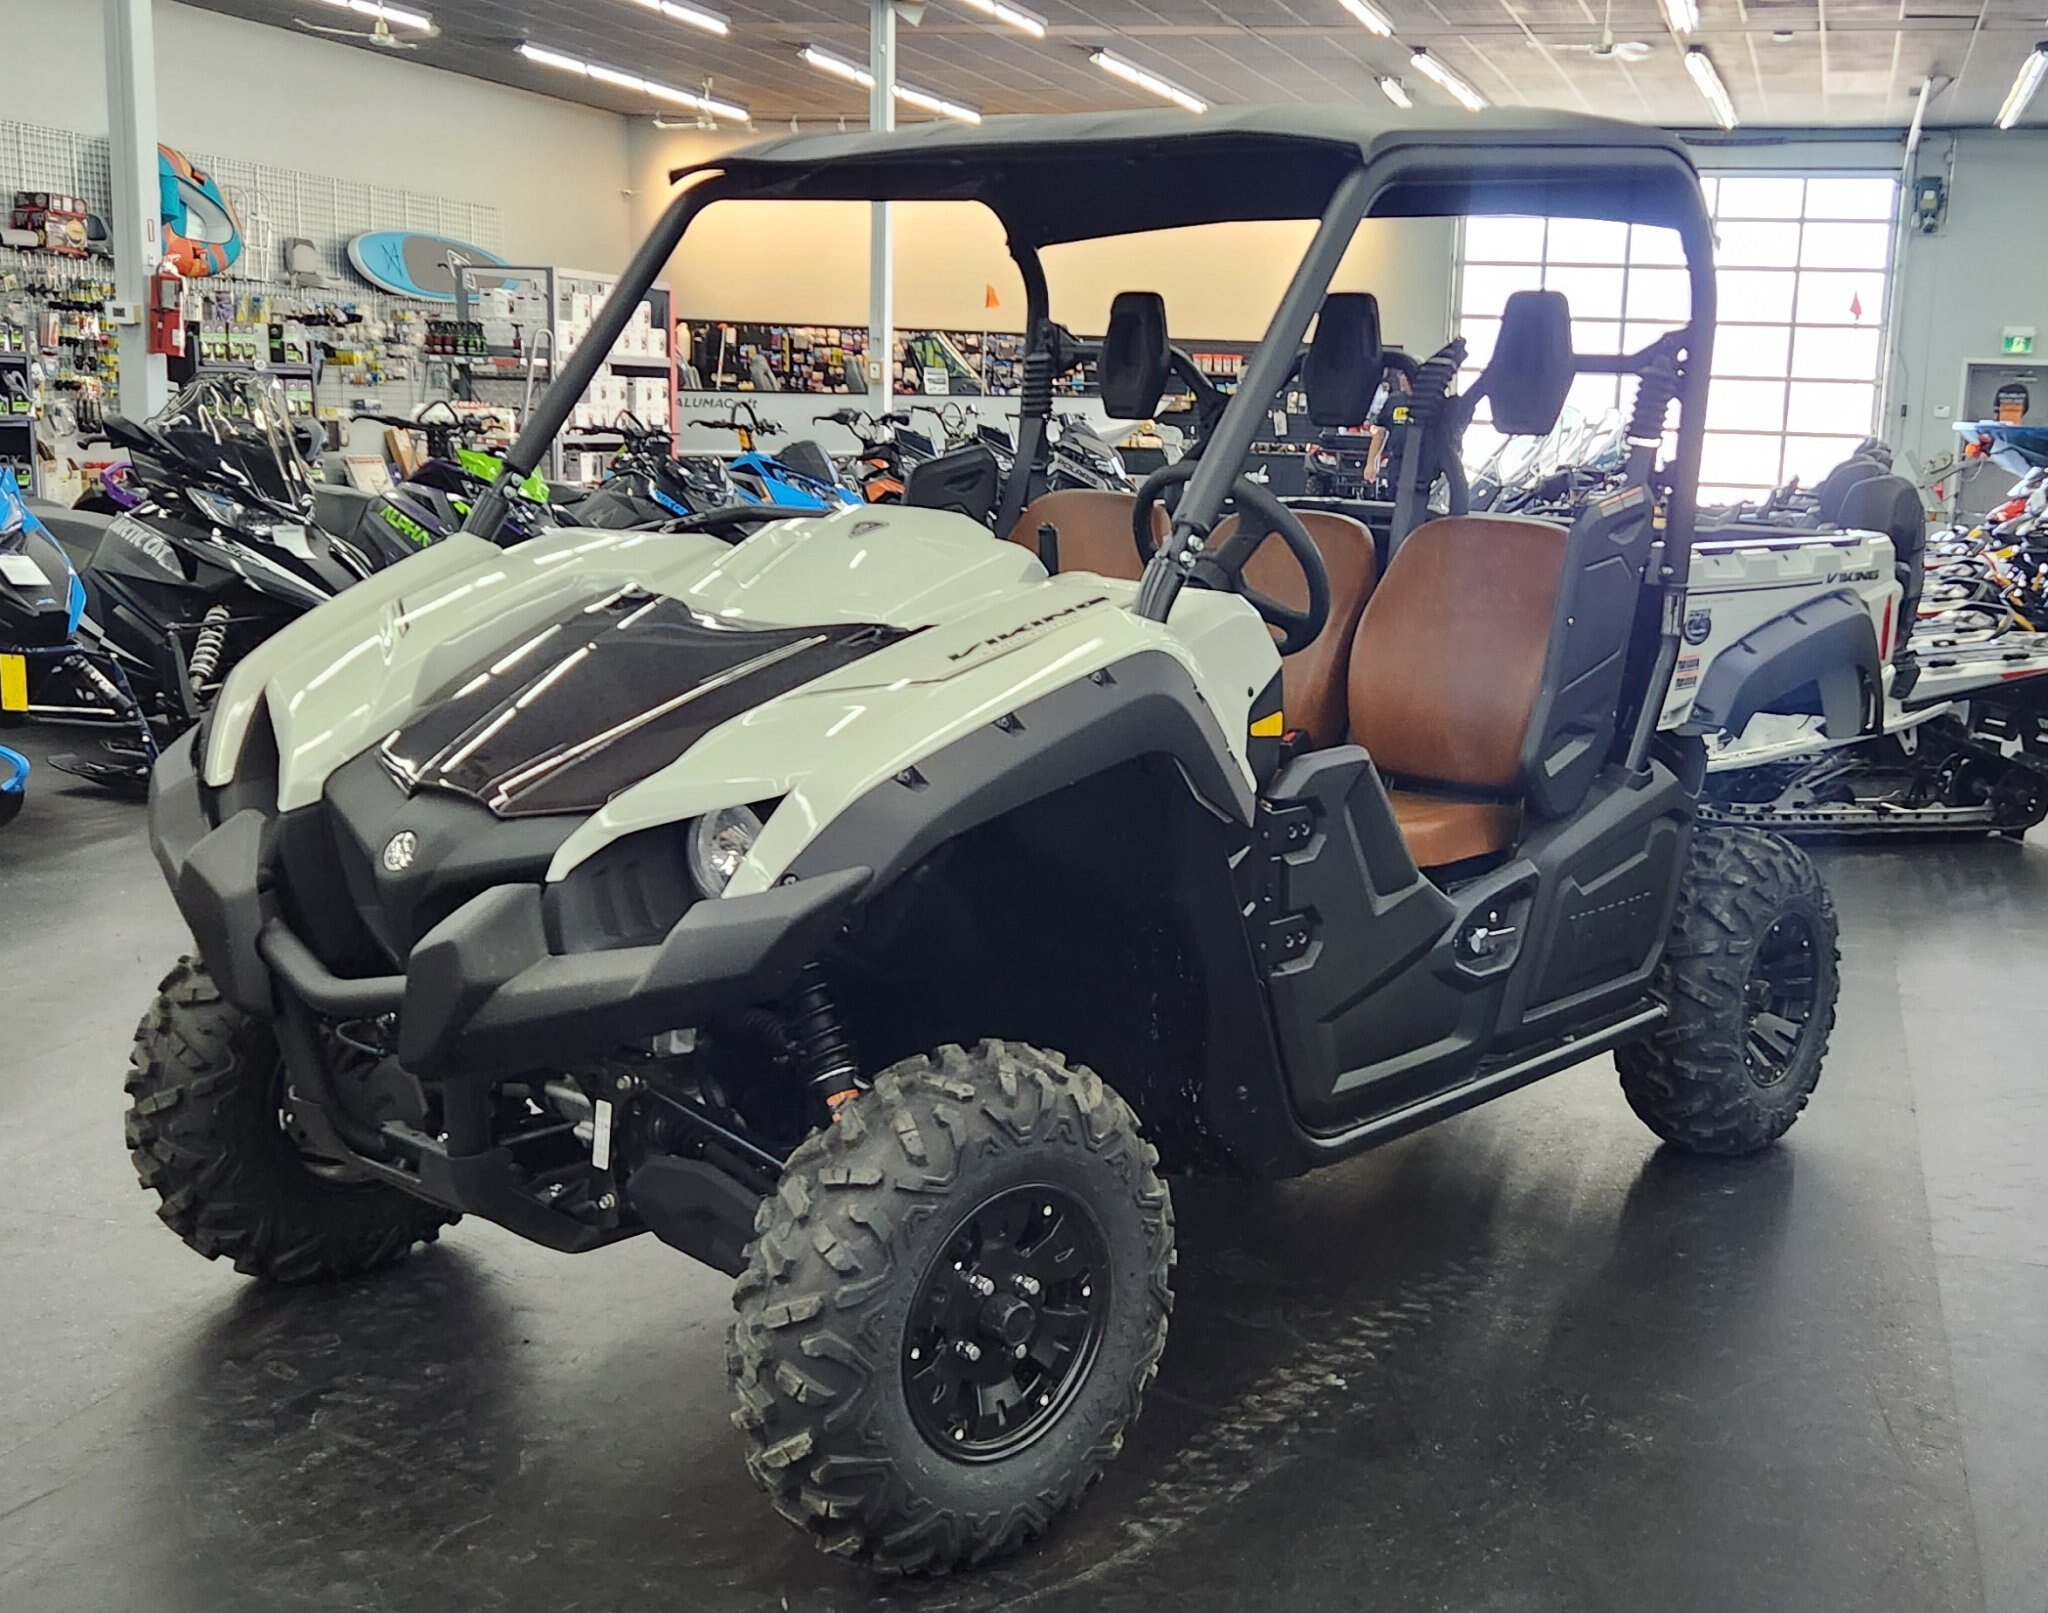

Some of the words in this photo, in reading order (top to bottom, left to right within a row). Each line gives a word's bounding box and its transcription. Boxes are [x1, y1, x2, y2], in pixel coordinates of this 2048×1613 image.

[1057, 458, 1098, 486] POLARIS
[113, 517, 148, 548] ARCTIC
[143, 538, 172, 562] CAT
[380, 505, 432, 548] ALPHA
[1825, 569, 1879, 585] VIKING
